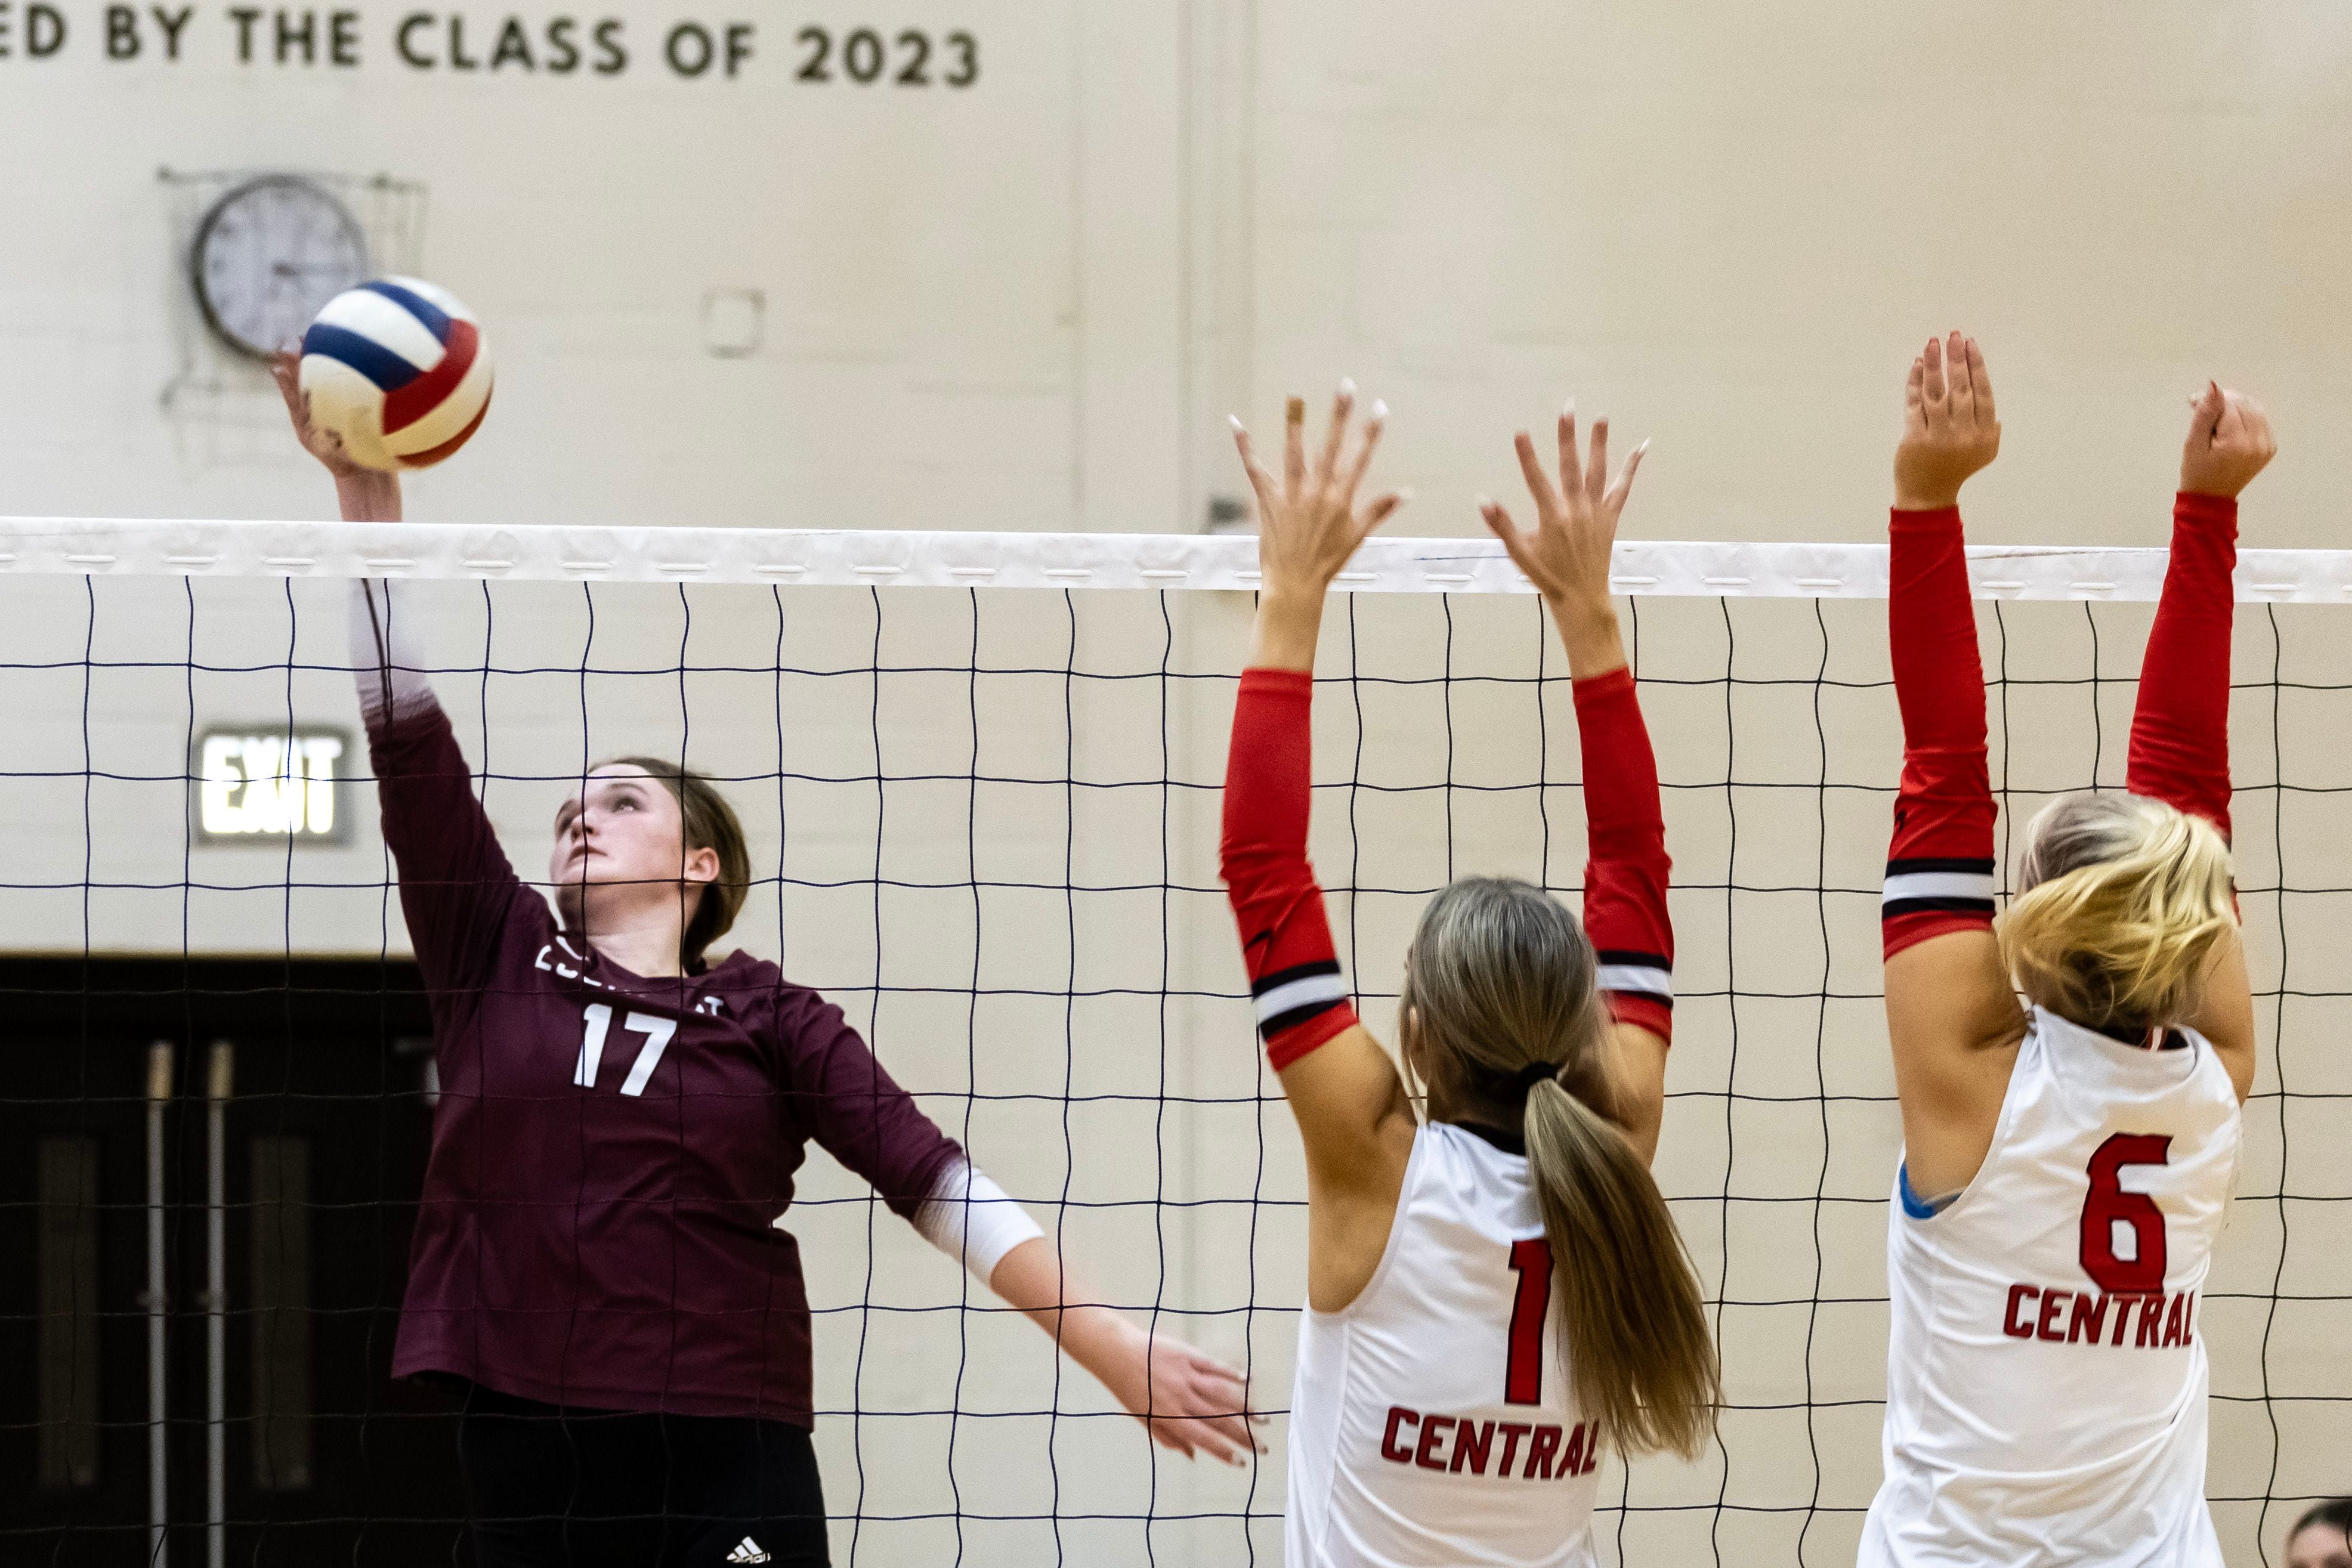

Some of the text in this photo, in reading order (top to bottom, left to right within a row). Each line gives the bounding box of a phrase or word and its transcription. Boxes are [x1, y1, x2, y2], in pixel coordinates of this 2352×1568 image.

[104, 5, 192, 61] BY
[230, 8, 360, 66] THE
[395, 12, 629, 75] CLASS
[664, 20, 754, 79] OF
[795, 24, 980, 88] 2023
[202, 735, 342, 833] EXIT
[574, 1003, 677, 1096] 17
[2079, 1131, 2173, 1294] 6
[1504, 1238, 1555, 1406] 1
[2002, 1284, 2195, 1349] CENTRAL
[1381, 1406, 1599, 1480] CENTRAL
